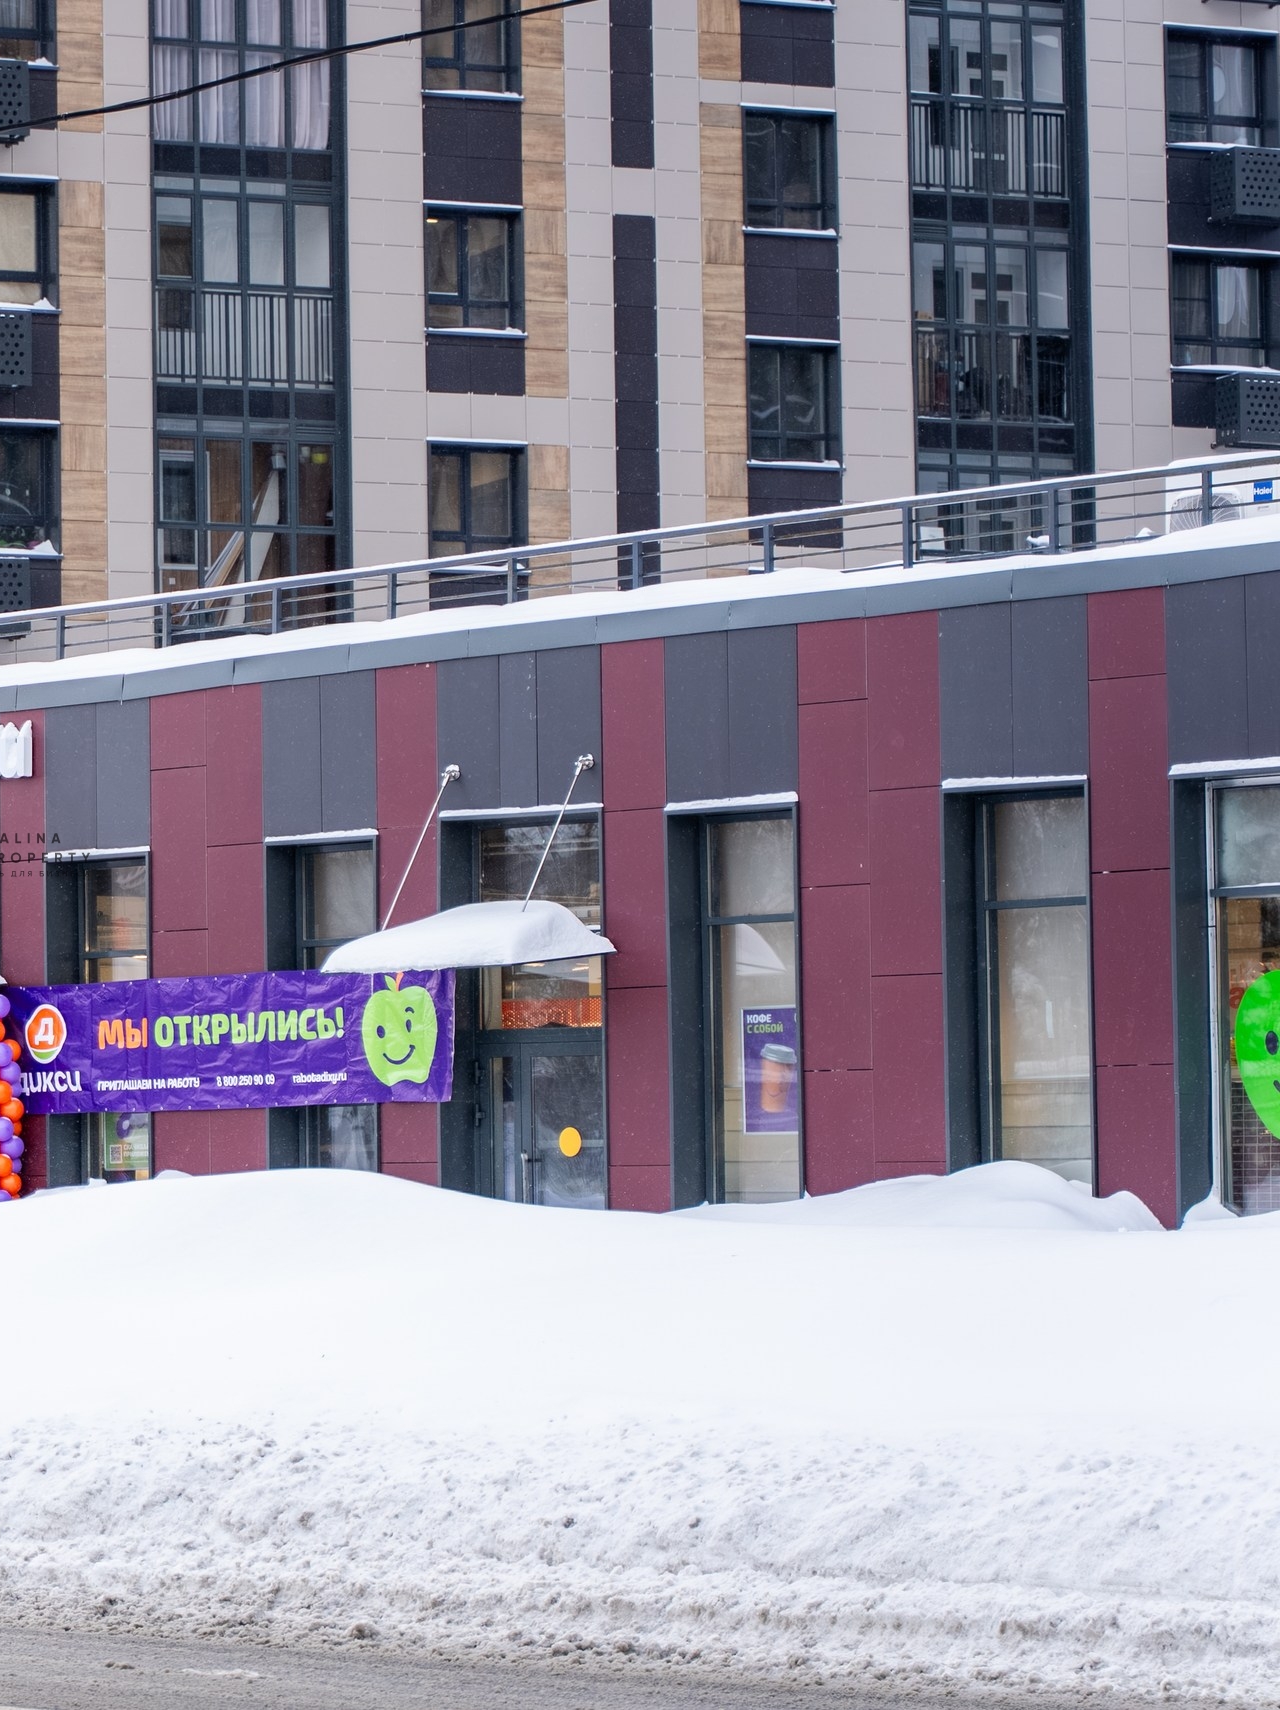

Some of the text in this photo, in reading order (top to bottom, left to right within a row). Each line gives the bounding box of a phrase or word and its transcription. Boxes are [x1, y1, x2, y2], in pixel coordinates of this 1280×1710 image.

[1253, 486, 1273, 495] Haier
[746, 1013, 772, 1023] КОФЕ
[34, 1017, 55, 1046] Д
[97, 1006, 345, 1050] МЫ ОТКРЫЛИСЬ!
[747, 1021, 784, 1034] С СОБОЙ
[97, 1077, 200, 1091] ПРИГЛАШАЕМ НА РАБОТУ
[216, 1073, 275, 1087] 8 800 250 90 09
[292, 1071, 347, 1084] rabotadixy.ru
